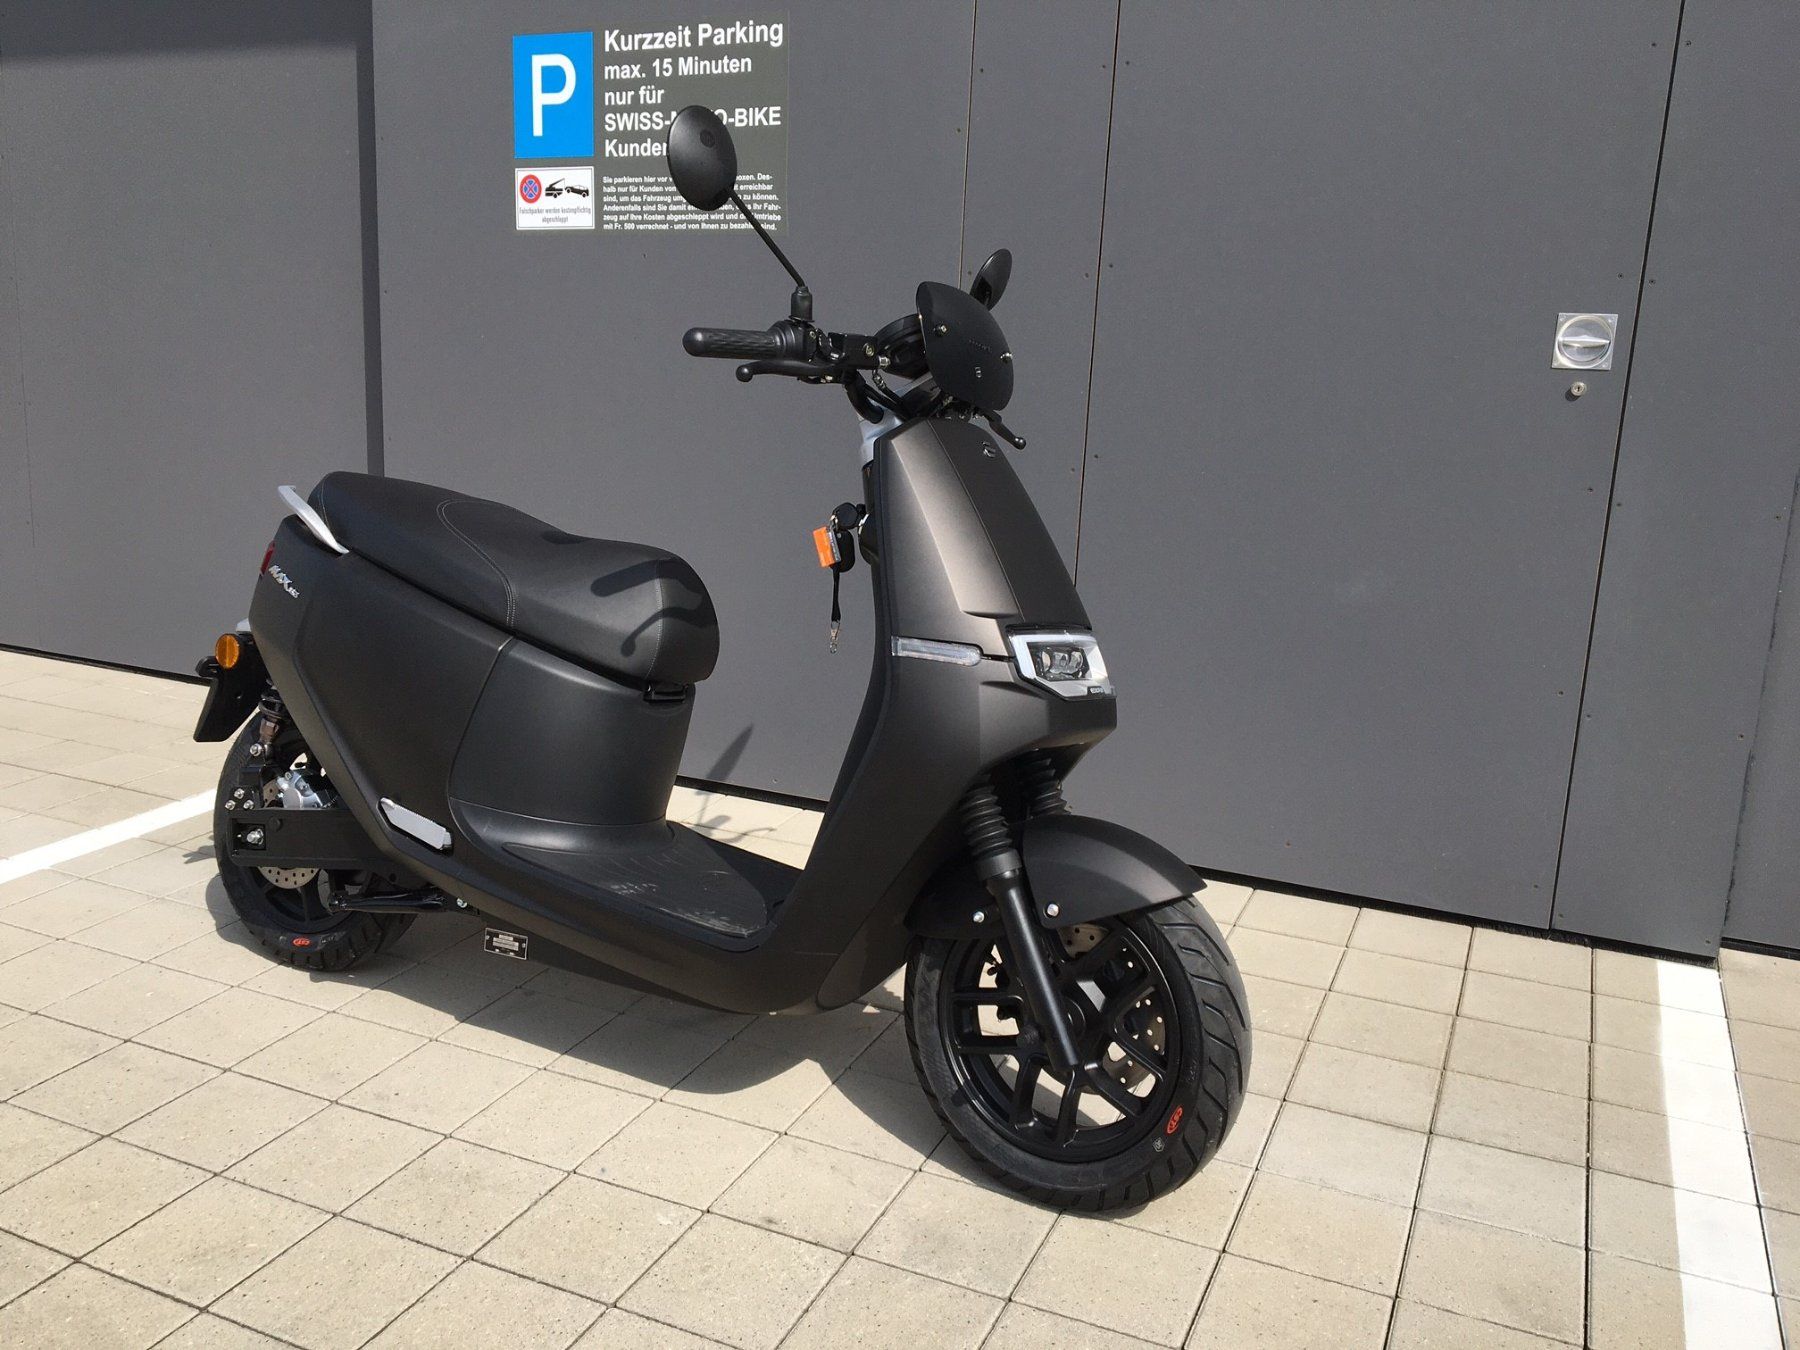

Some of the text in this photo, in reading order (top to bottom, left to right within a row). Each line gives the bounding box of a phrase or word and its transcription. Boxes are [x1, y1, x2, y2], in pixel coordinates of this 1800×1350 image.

[604, 20, 783, 52] Kurzzeit Parking
[604, 55, 752, 80] max. 15 Minuten
[531, 53, 577, 137] P
[604, 85, 665, 106] nur für
[604, 106, 782, 132] SWISS-O-BIKE
[613, 176, 643, 185] parkieren
[739, 183, 773, 191] erreichbar
[602, 195, 618, 203] sind,
[642, 194, 672, 203] Fahrzeug
[752, 193, 779, 201] können.
[657, 203, 668, 211] Sie
[668, 203, 687, 211] damit
[763, 203, 781, 211] Fahr-
[643, 213, 666, 221] Kosten
[666, 213, 710, 222] abgeschleppt
[710, 212, 725, 220] wird
[725, 212, 739, 220] und
[614, 222, 624, 230] Fr.
[624, 222, 636, 230] 500
[636, 222, 670, 230] verrechnet
[674, 222, 687, 230] und
[700, 222, 720, 230] Ihnen
